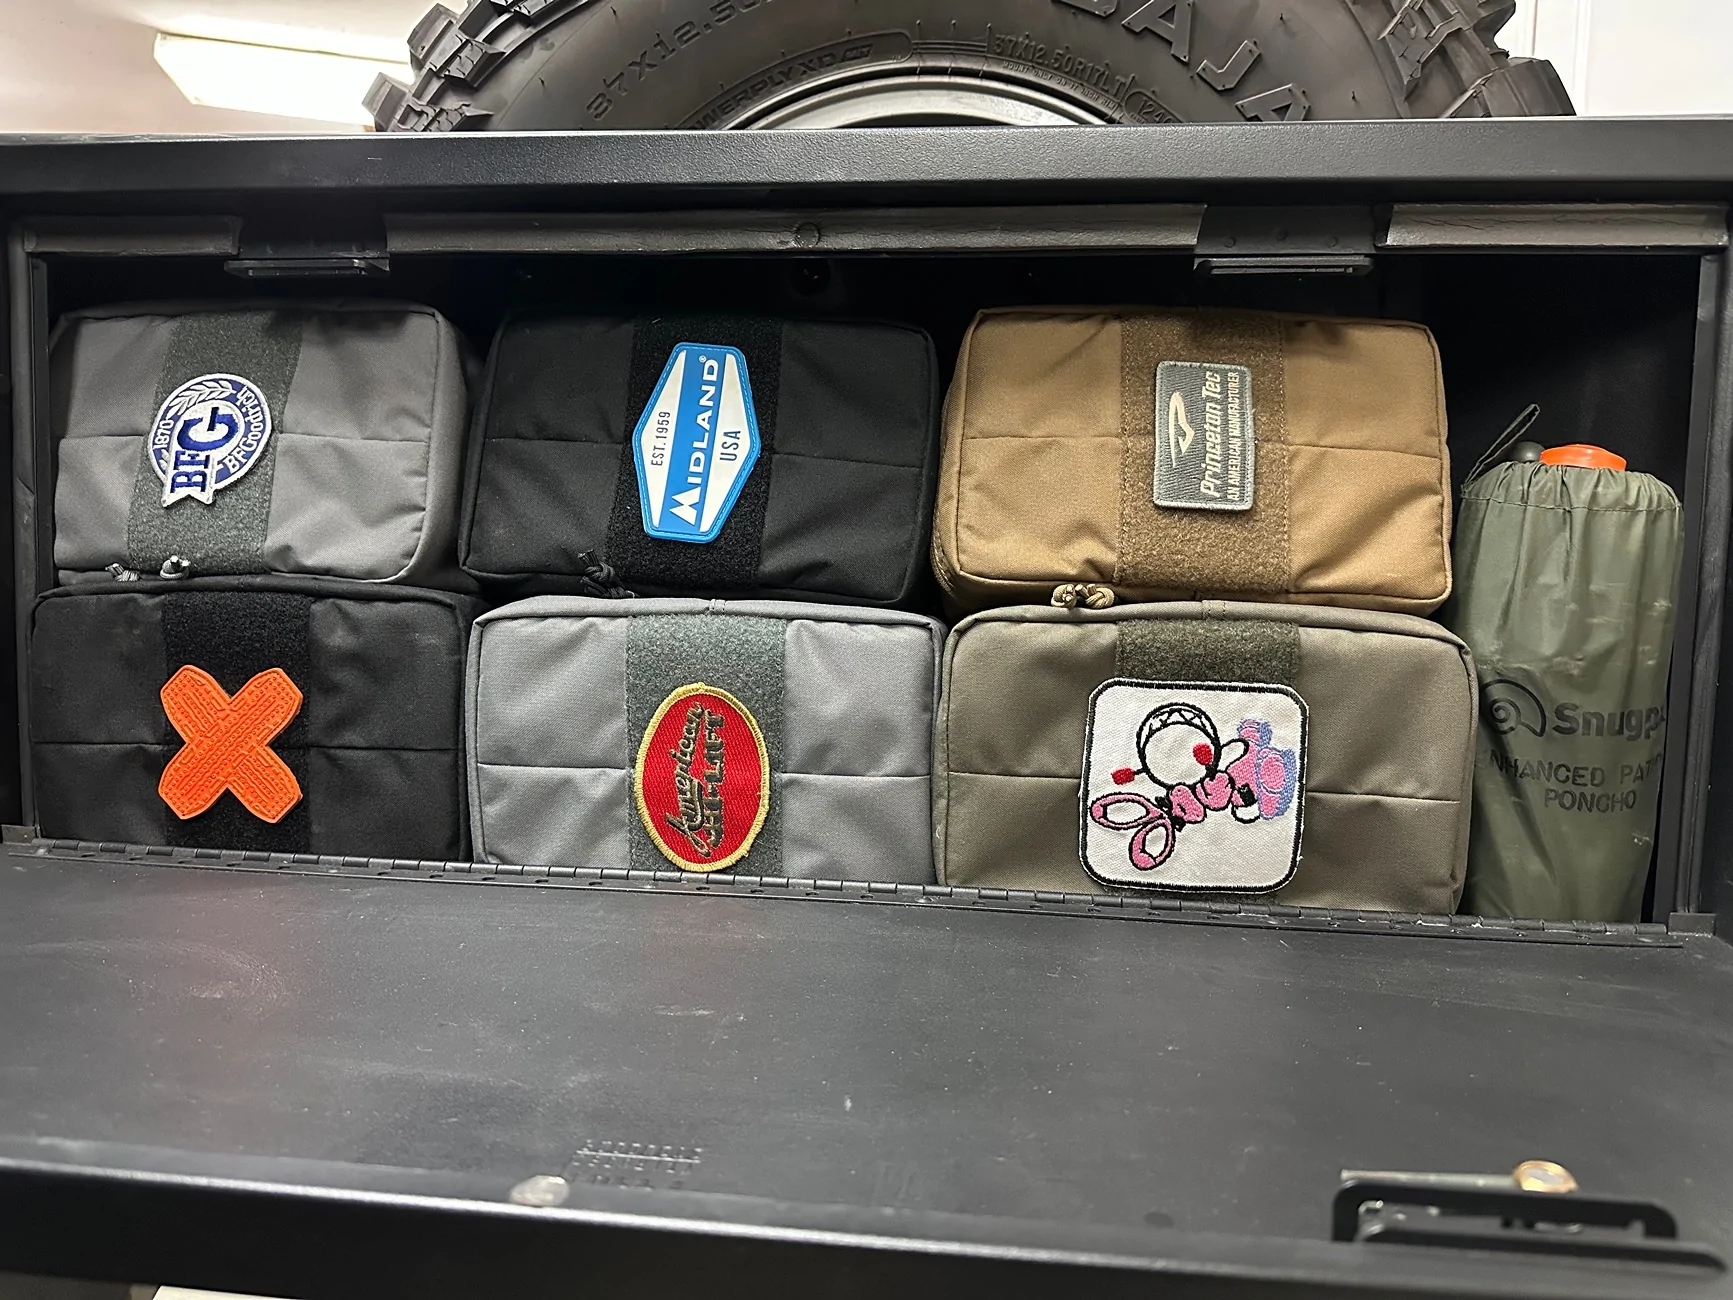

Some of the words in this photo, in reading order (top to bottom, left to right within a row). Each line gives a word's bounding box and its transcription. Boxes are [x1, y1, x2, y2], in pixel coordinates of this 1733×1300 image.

[994, 34, 1127, 97] 37X12.50R17LT
[1003, 60, 1029, 73] MOUNT
[1033, 67, 1052, 81] ONLY
[1056, 77, 1067, 87] ON
[1081, 85, 1099, 102] INCH
[1101, 94, 1118, 109] RIM
[1201, 370, 1221, 399] Tec
[1227, 371, 1241, 437] MANUFACTURER
[153, 419, 175, 450] 1870
[170, 406, 239, 494] BFG
[223, 386, 263, 474] BFGoodrich
[669, 358, 719, 526] MIDLAND
[719, 430, 741, 462] USA
[1200, 401, 1221, 498] Princeton
[1227, 437, 1241, 486] AMERICAN
[1227, 486, 1240, 501] AN
[664, 701, 712, 858] American
[1486, 749, 1606, 788] NHANCED
[1544, 788, 1638, 814] PONCHO
